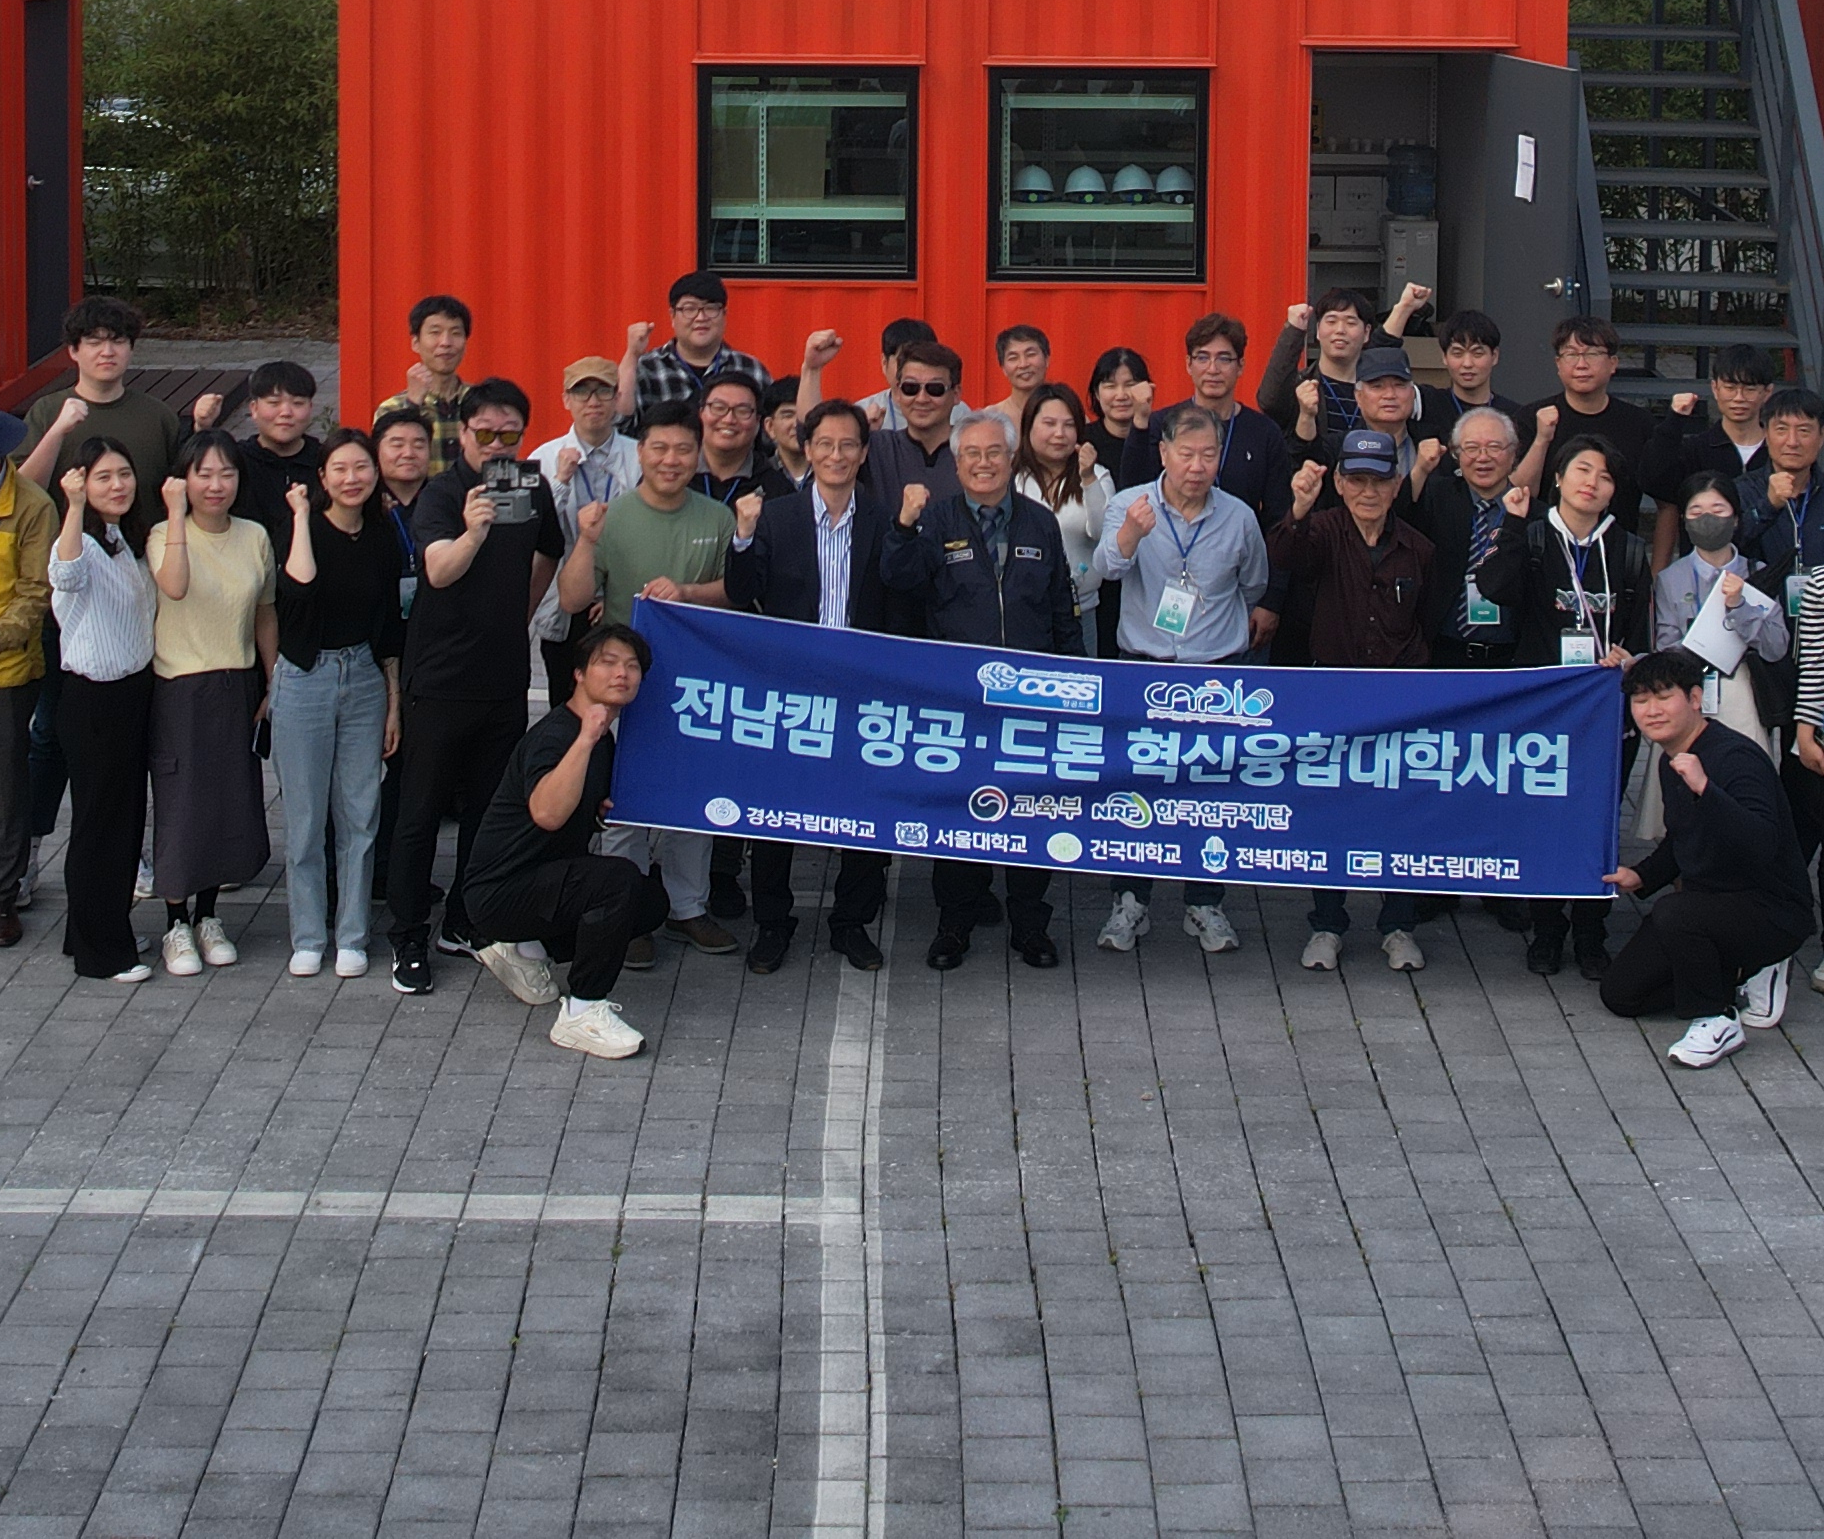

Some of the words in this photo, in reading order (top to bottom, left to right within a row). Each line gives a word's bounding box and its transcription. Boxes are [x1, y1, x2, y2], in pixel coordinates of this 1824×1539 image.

[1018, 677, 1097, 701] COSS
[1062, 699, 1094, 710] 항공드론
[671, 676, 838, 759] 전남캠
[857, 700, 1106, 782] 항공·드론
[1126, 728, 1570, 797] 혁신융합대학사업
[1010, 794, 1083, 820] 교육부
[1091, 802, 1142, 823] NRF
[1153, 799, 1293, 830] 한국연구재단
[746, 807, 876, 840] 경상국립대학교
[934, 828, 1028, 855] 서울대학교
[1090, 839, 1182, 864] 건국대학교
[1236, 846, 1328, 872] 전북대학교
[1390, 852, 1521, 882] 전남도립대학교
